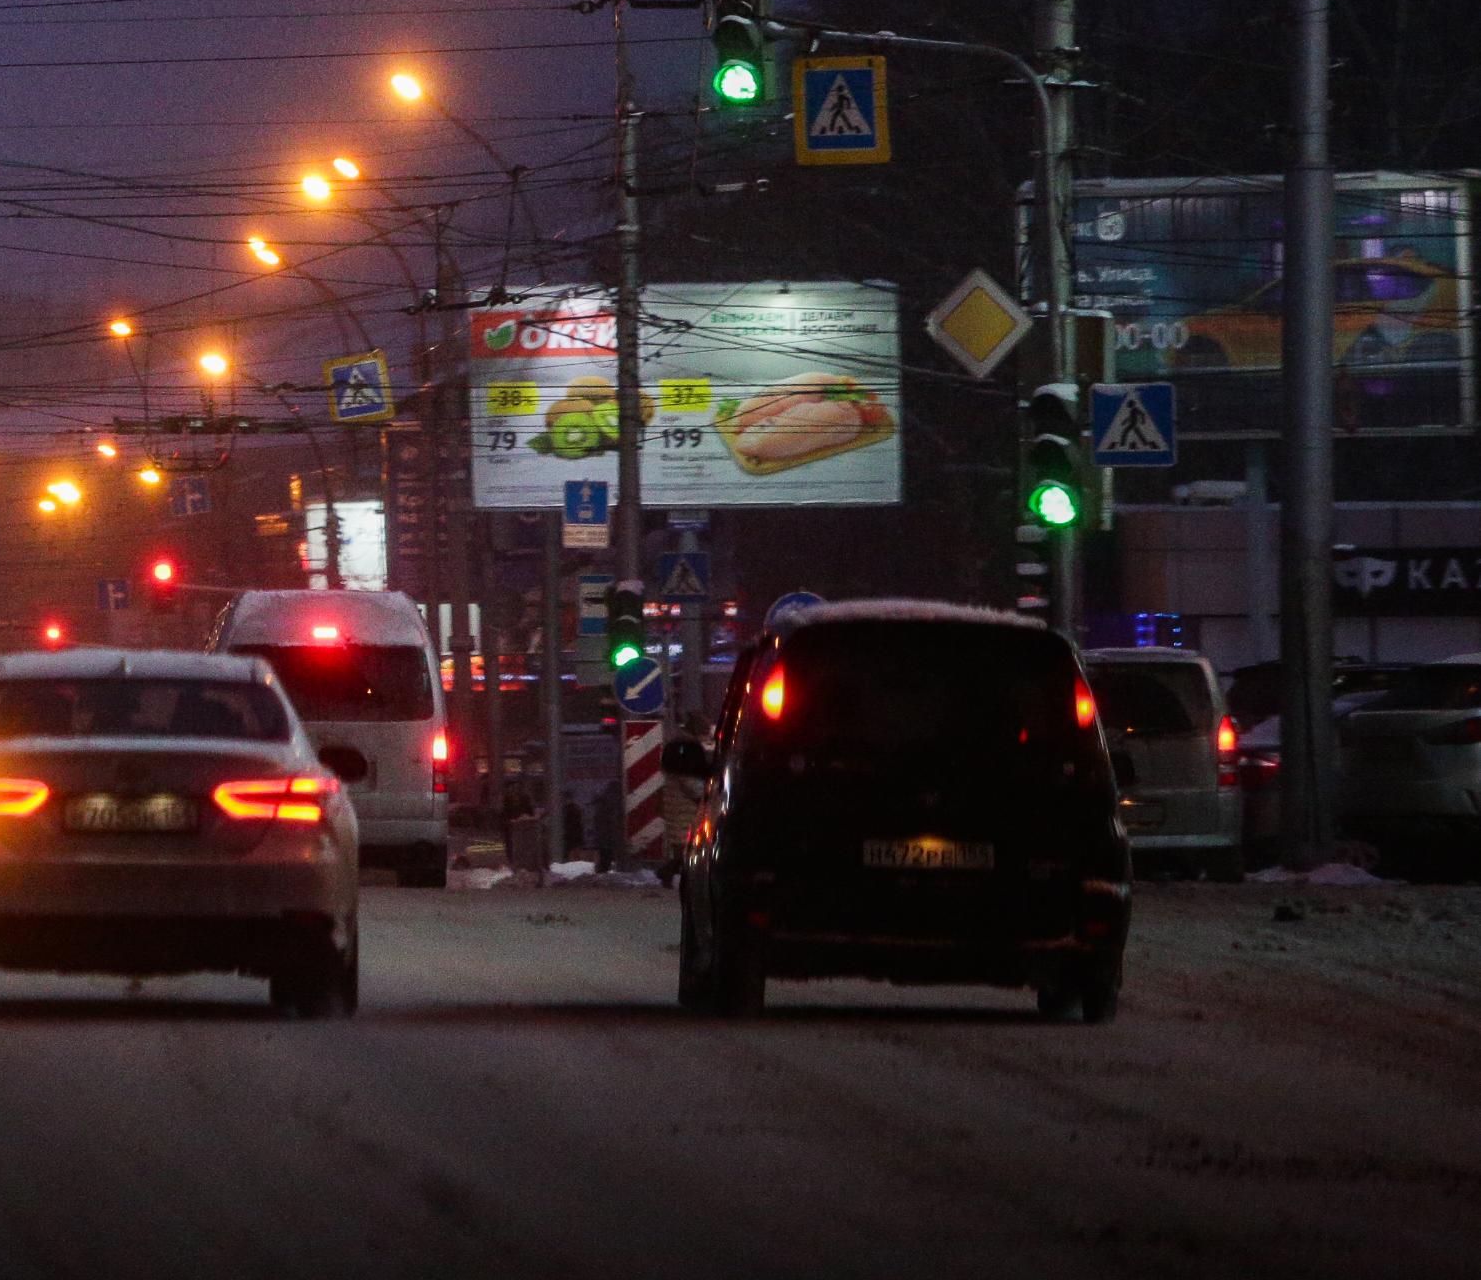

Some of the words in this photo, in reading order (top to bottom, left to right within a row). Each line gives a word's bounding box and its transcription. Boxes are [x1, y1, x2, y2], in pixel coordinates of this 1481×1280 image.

[488, 432, 517, 452] 79
[662, 428, 702, 449] 199
[1408, 558, 1481, 589] КА
